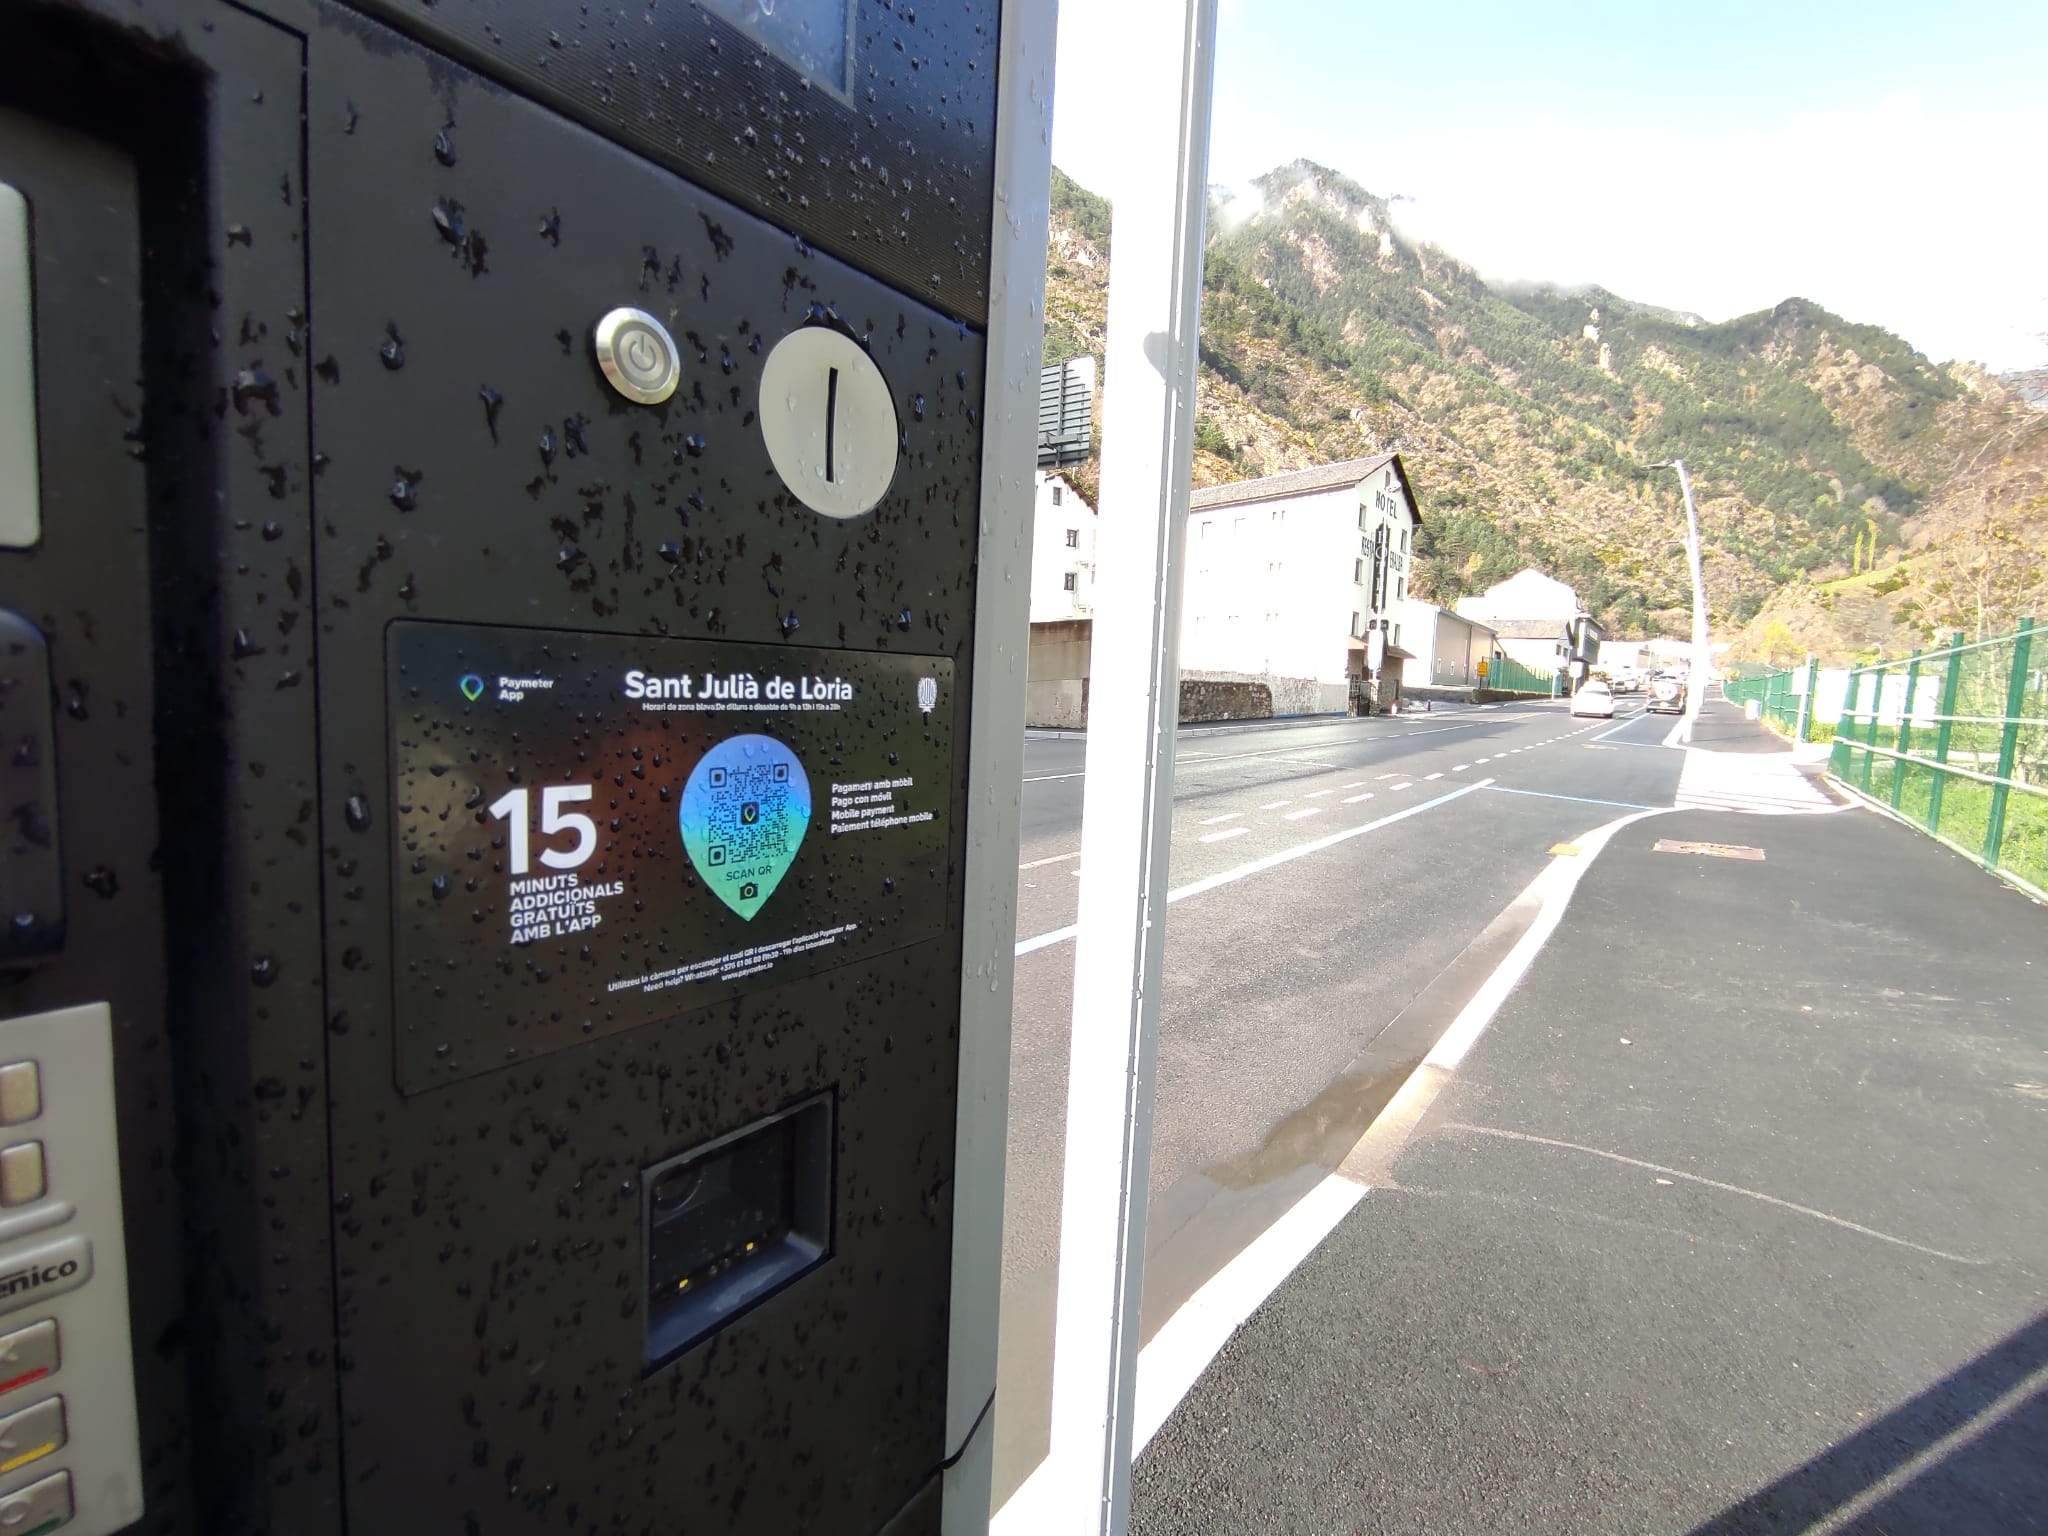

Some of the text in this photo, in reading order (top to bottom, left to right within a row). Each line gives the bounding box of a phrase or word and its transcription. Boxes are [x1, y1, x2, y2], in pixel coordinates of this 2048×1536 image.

[1375, 490, 1398, 519] HOTEL
[499, 677, 554, 690] Paymeter
[624, 671, 853, 702] Sant Julià de Lòria
[499, 689, 525, 702] App
[642, 702, 666, 711] Horari
[667, 703, 677, 711] de
[678, 703, 695, 711] zona
[726, 703, 748, 711] dilluns
[754, 703, 779, 711] dissabte
[780, 703, 788, 711] de
[874, 780, 891, 789] amb
[891, 777, 913, 787] mòbil
[831, 791, 892, 807] Pago con móvil
[831, 805, 895, 820] Mobile payment
[831, 812, 933, 833] Paiement téléphone mobile
[488, 784, 598, 875] 15
[726, 865, 772, 881] SCAN QR
[509, 873, 579, 896] MINUTS
[509, 881, 624, 912] ADDICIONALS
[510, 901, 596, 927] GRATUÏTS
[509, 915, 602, 944] AMB L'APP
[608, 978, 640, 992] Utilitzeu
[641, 975, 649, 983] la
[650, 969, 676, 981] càmera
[677, 966, 689, 975] per
[690, 957, 721, 971] escanejar
[722, 954, 729, 962] el
[730, 951, 743, 961] codi
[643, 982, 664, 992] Need
[665, 975, 684, 988] help?
